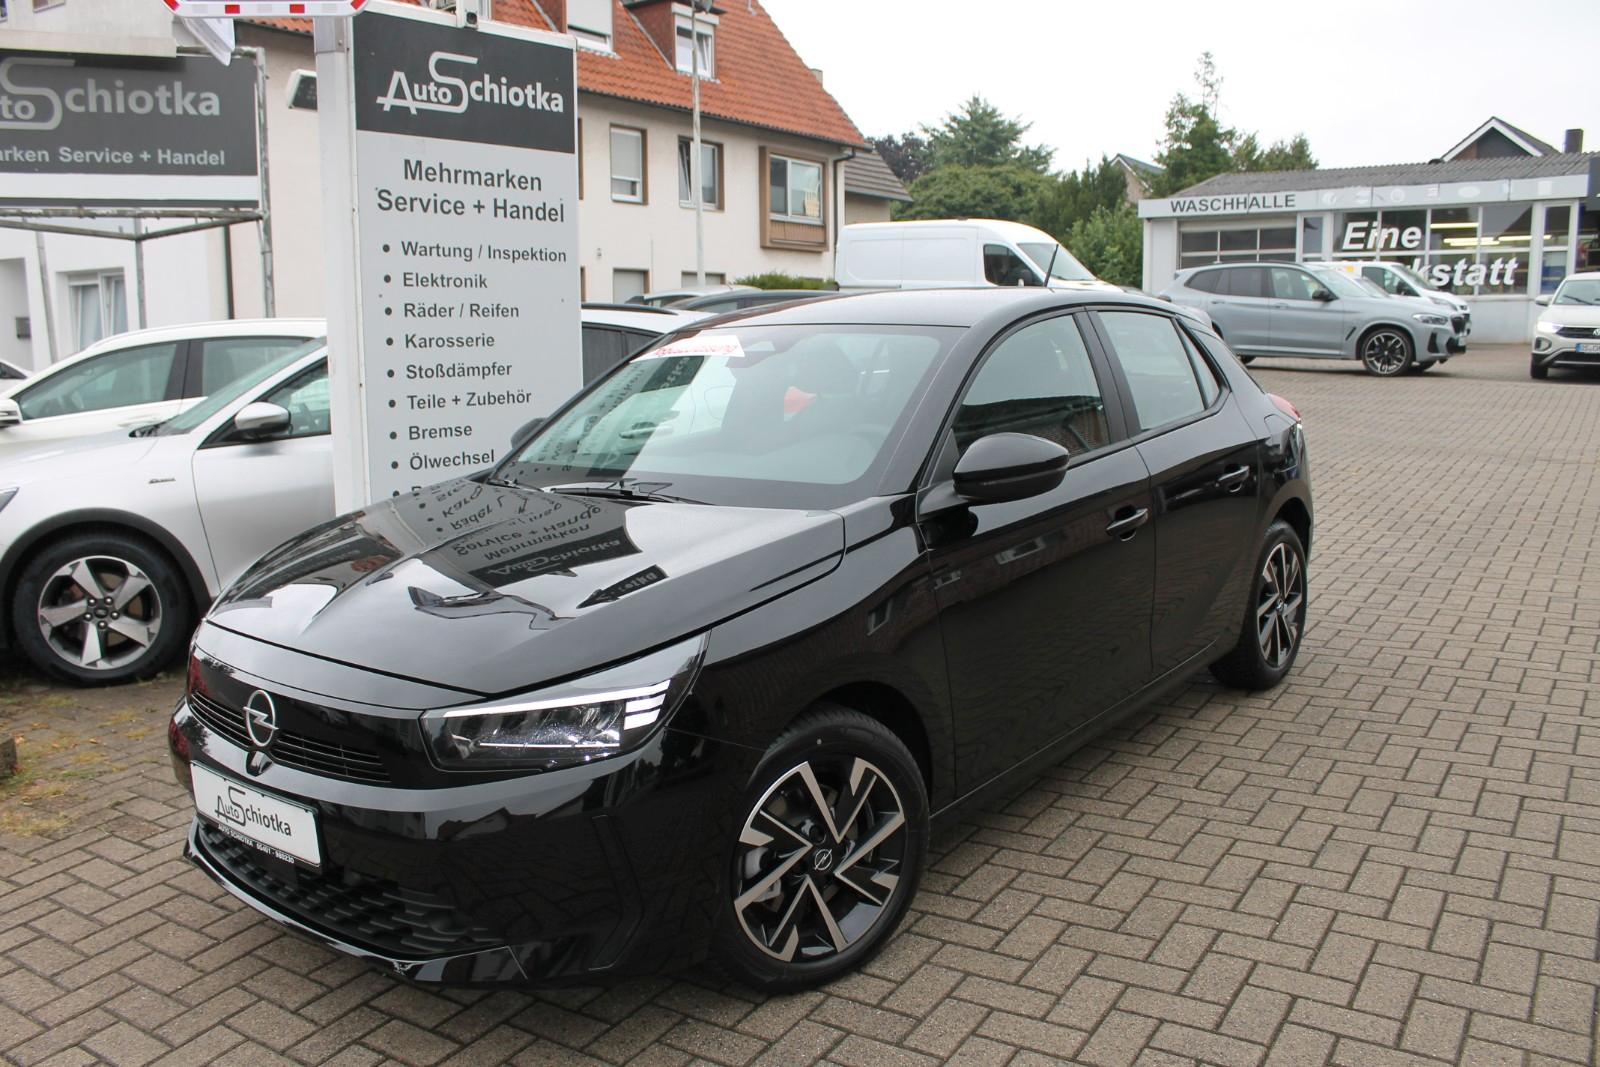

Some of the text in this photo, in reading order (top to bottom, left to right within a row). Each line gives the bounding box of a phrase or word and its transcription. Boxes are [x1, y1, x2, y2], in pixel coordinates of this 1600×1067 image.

[376, 51, 564, 115] Auto Schiotka
[58, 147, 134, 163] Service
[157, 149, 225, 165] Handel
[403, 158, 542, 191] Mehrmarken
[377, 188, 565, 223] Service + Handel
[1170, 194, 1296, 213] WASCHHALLE
[1342, 221, 1422, 250] Eine
[401, 240, 473, 262] Wartung
[488, 244, 567, 263] Inspektion
[403, 272, 488, 289] Elektronik
[1409, 256, 1519, 287] kstatt
[404, 302, 454, 318] Räder
[469, 303, 519, 318] Reifen
[405, 333, 495, 349] Karosserie
[406, 361, 513, 380] Stoßdämpfer
[407, 393, 446, 410] Teile
[466, 389, 532, 407] Zubehör
[408, 424, 473, 441] Bremse
[409, 449, 495, 471] Ölwechsel
[228, 786, 293, 837] Schiotka
